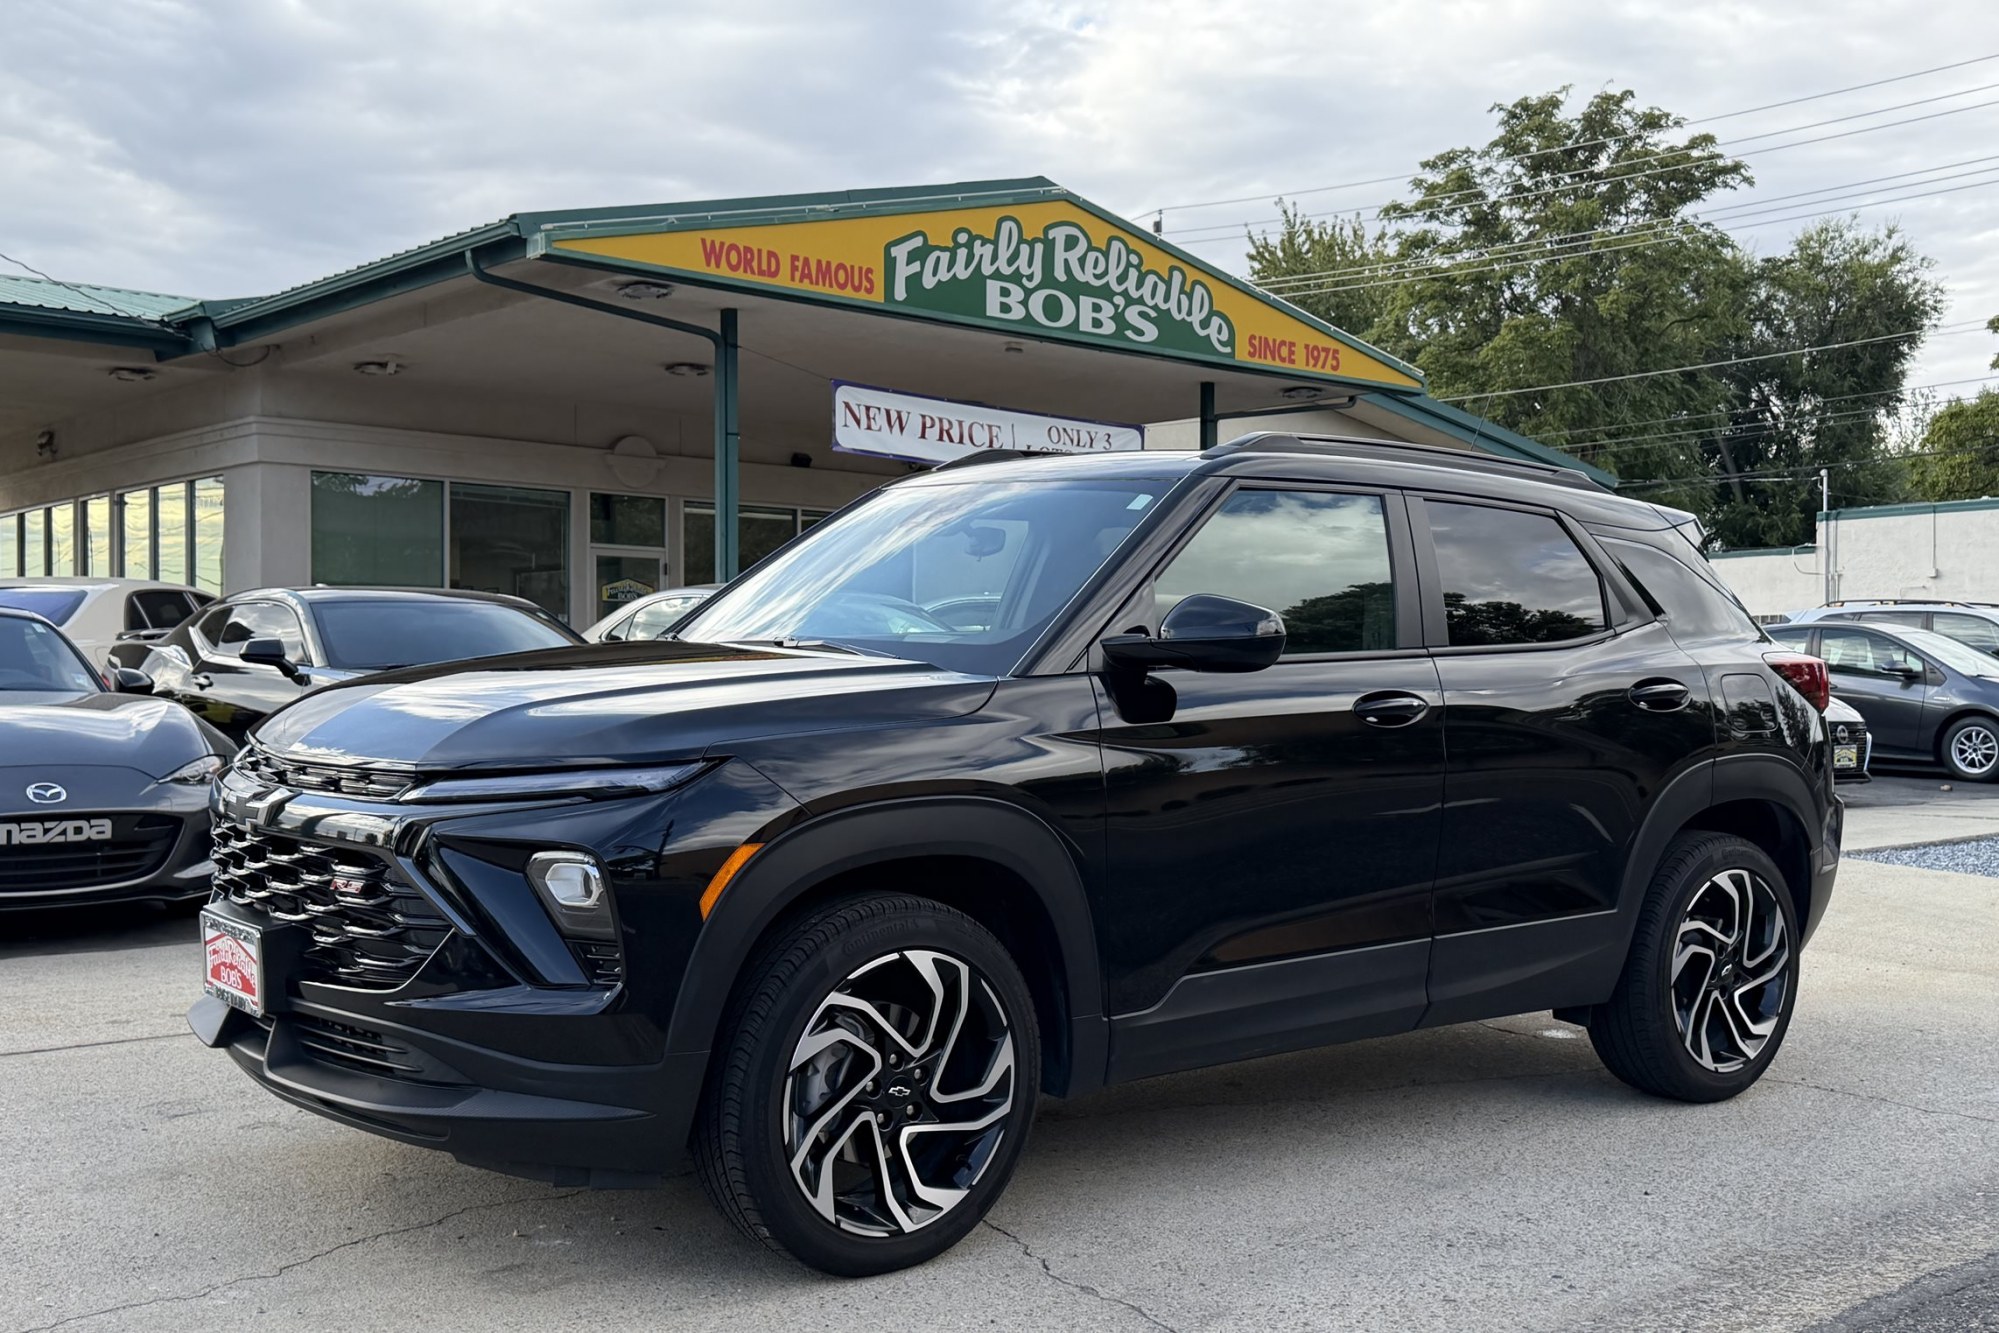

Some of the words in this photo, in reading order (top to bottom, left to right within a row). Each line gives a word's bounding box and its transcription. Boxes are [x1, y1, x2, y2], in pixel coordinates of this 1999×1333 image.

[700, 237, 781, 279] WORLD
[789, 253, 875, 295] FAMOUS
[890, 219, 1044, 302] Fairly
[1047, 225, 1232, 354] Reliable
[985, 278, 1159, 343] BOB'S
[1247, 333, 1297, 366] SINCE
[1303, 345, 1341, 373] 1975
[841, 400, 912, 437] NEW
[917, 412, 1005, 449] PRICE
[1046, 425, 1098, 450] ONLY
[1102, 432, 1113, 451] 3
[330, 878, 364, 894] RS
